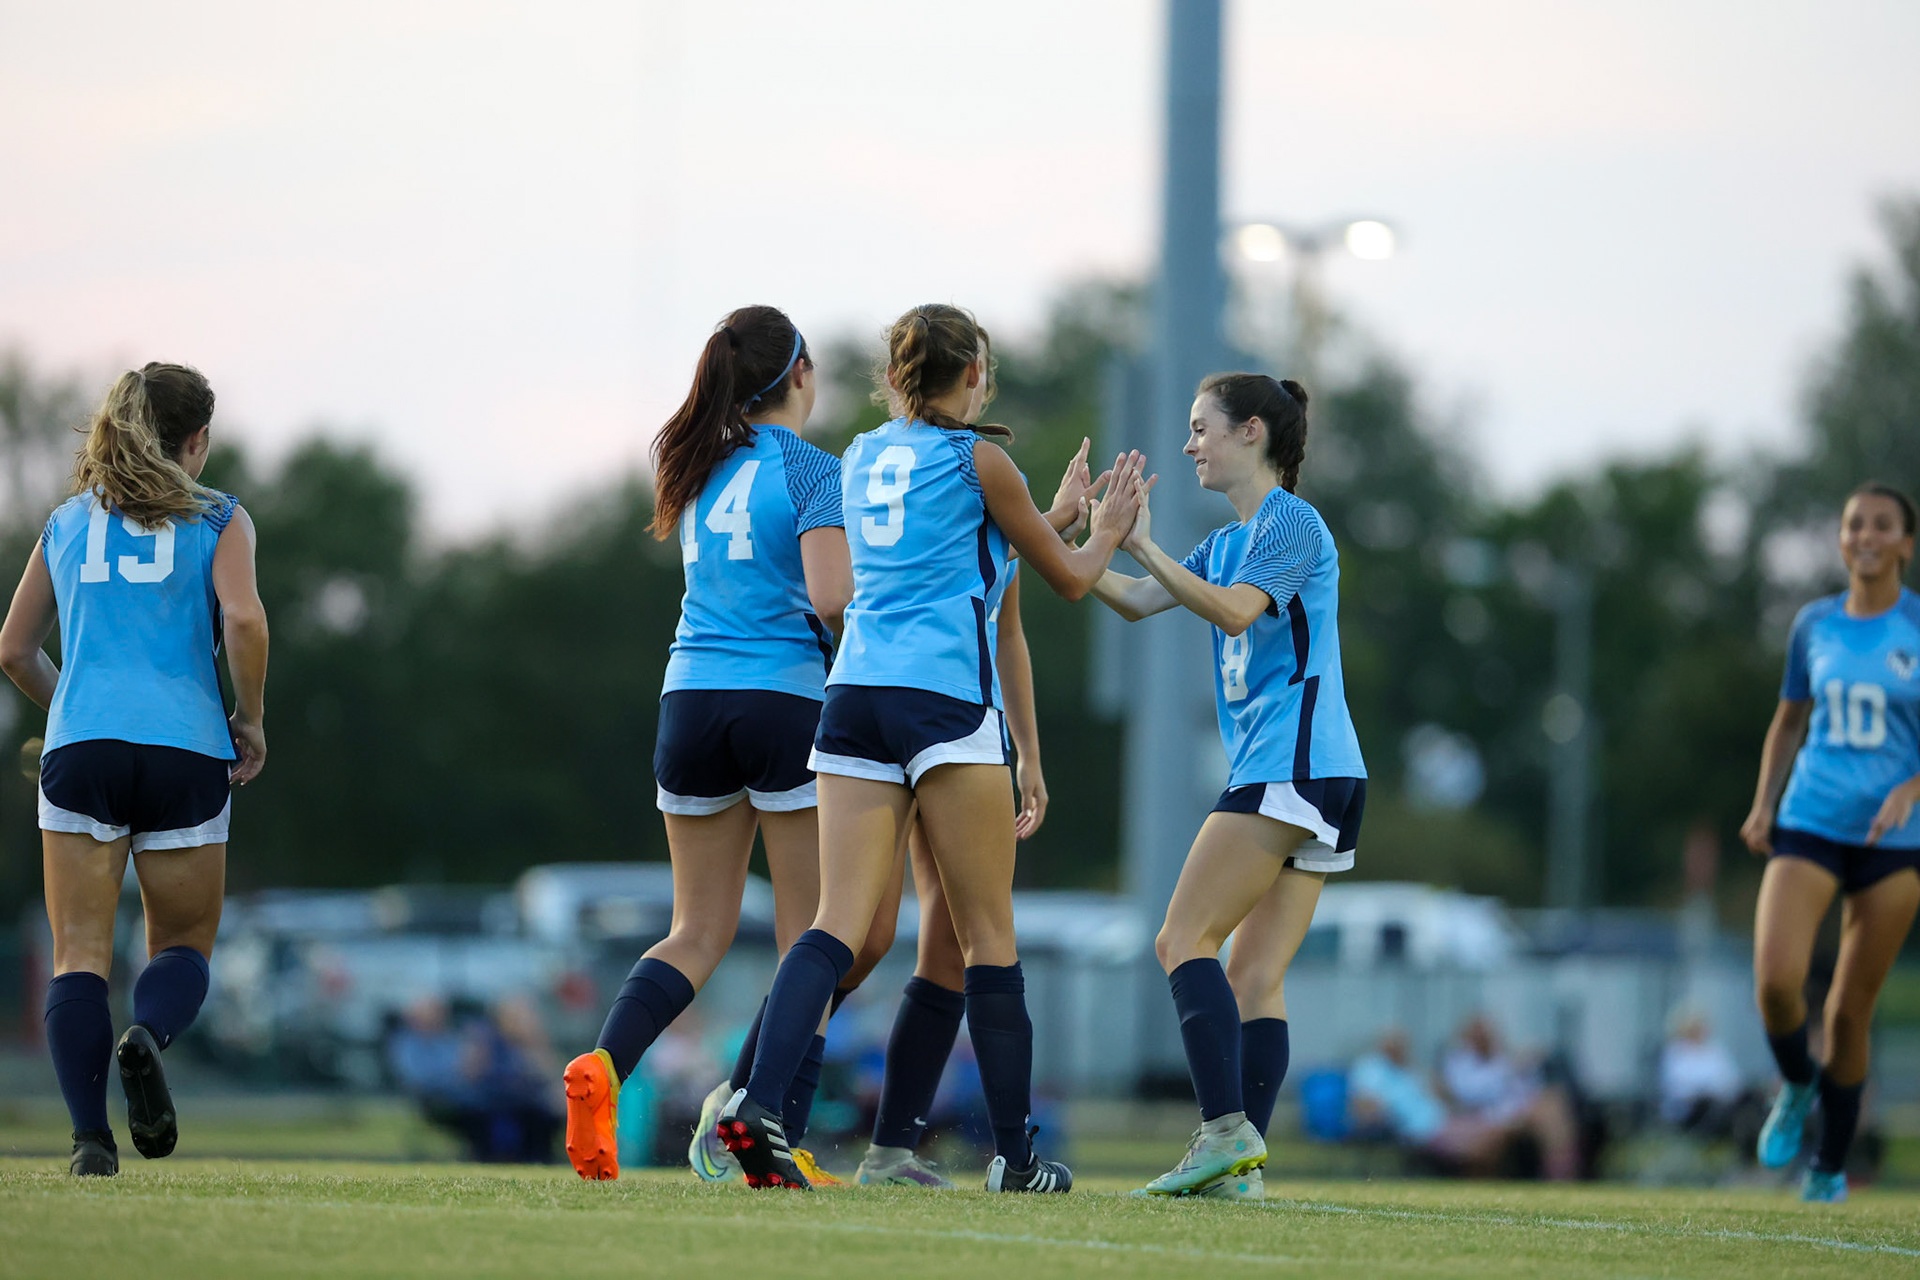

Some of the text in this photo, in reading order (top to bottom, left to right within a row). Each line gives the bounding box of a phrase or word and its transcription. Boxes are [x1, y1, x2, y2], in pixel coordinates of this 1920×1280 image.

[682, 460, 761, 561] 14
[861, 445, 917, 547] 9
[1221, 630, 1249, 702] 8
[1825, 678, 1887, 748] 10
